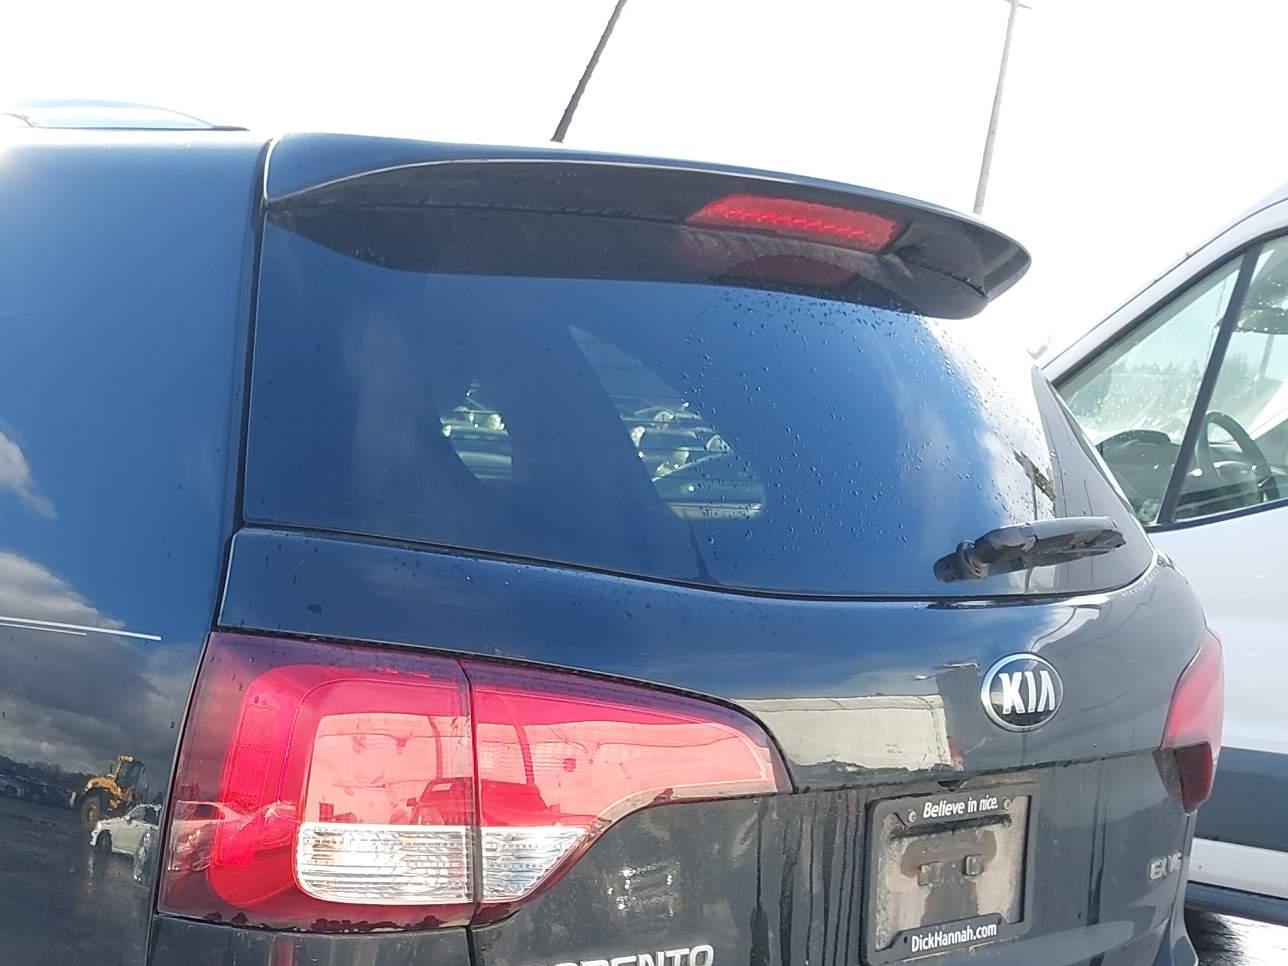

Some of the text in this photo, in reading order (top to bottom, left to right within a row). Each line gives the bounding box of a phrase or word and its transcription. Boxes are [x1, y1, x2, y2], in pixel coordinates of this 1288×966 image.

[998, 670, 1056, 715] KIA
[922, 794, 999, 819] Believe in nice.
[911, 923, 998, 953] DickHannah.com
